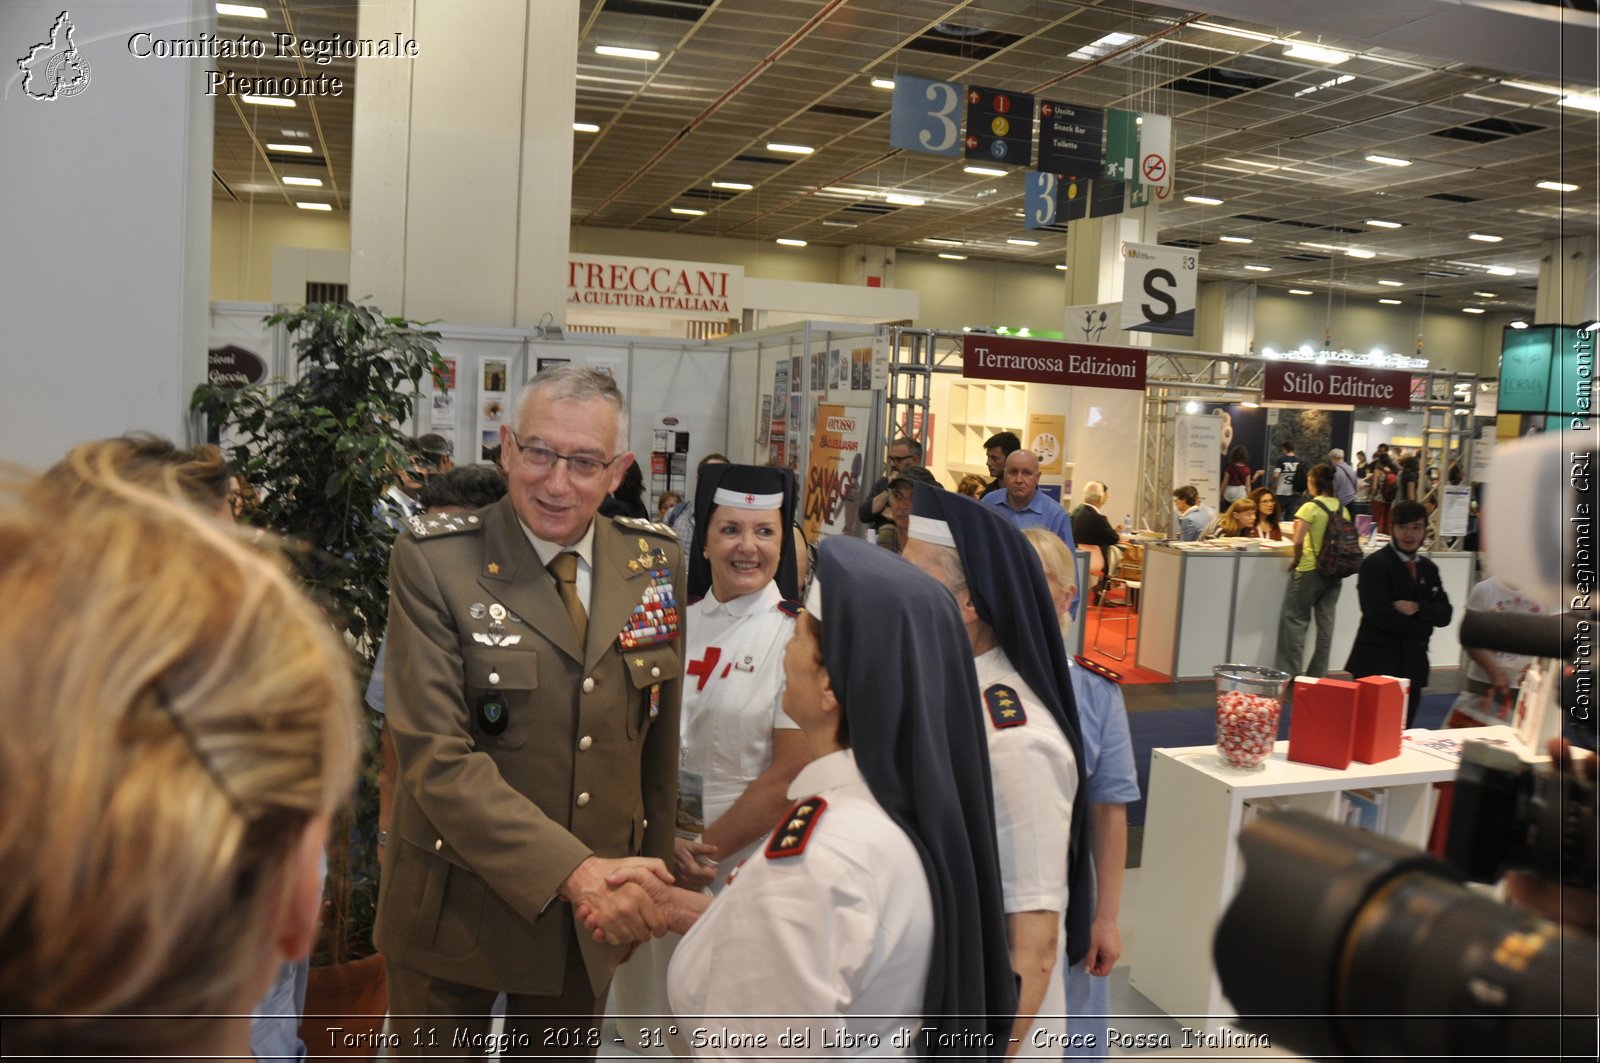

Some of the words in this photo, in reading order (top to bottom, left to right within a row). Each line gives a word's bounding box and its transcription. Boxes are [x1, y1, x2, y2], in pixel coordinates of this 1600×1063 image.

[998, 96, 1005, 112] 1
[1054, 105, 1075, 116] Uscita
[919, 82, 958, 151] 3
[995, 120, 1005, 133] 2
[1053, 122, 1074, 133] Snack
[1074, 124, 1086, 134] Bar
[994, 141, 1004, 155] 5
[1035, 172, 1054, 224] 3
[1187, 256, 1195, 270] 3
[567, 261, 729, 298] TRECCANI
[584, 291, 656, 308] CULTURA
[658, 295, 730, 313] ITALIANA
[1141, 267, 1177, 323] S
[974, 348, 1063, 373] Terrarossa
[1068, 354, 1137, 378] Edizioni
[1283, 371, 1324, 395] Stilo
[1327, 374, 1394, 399] Editrice
